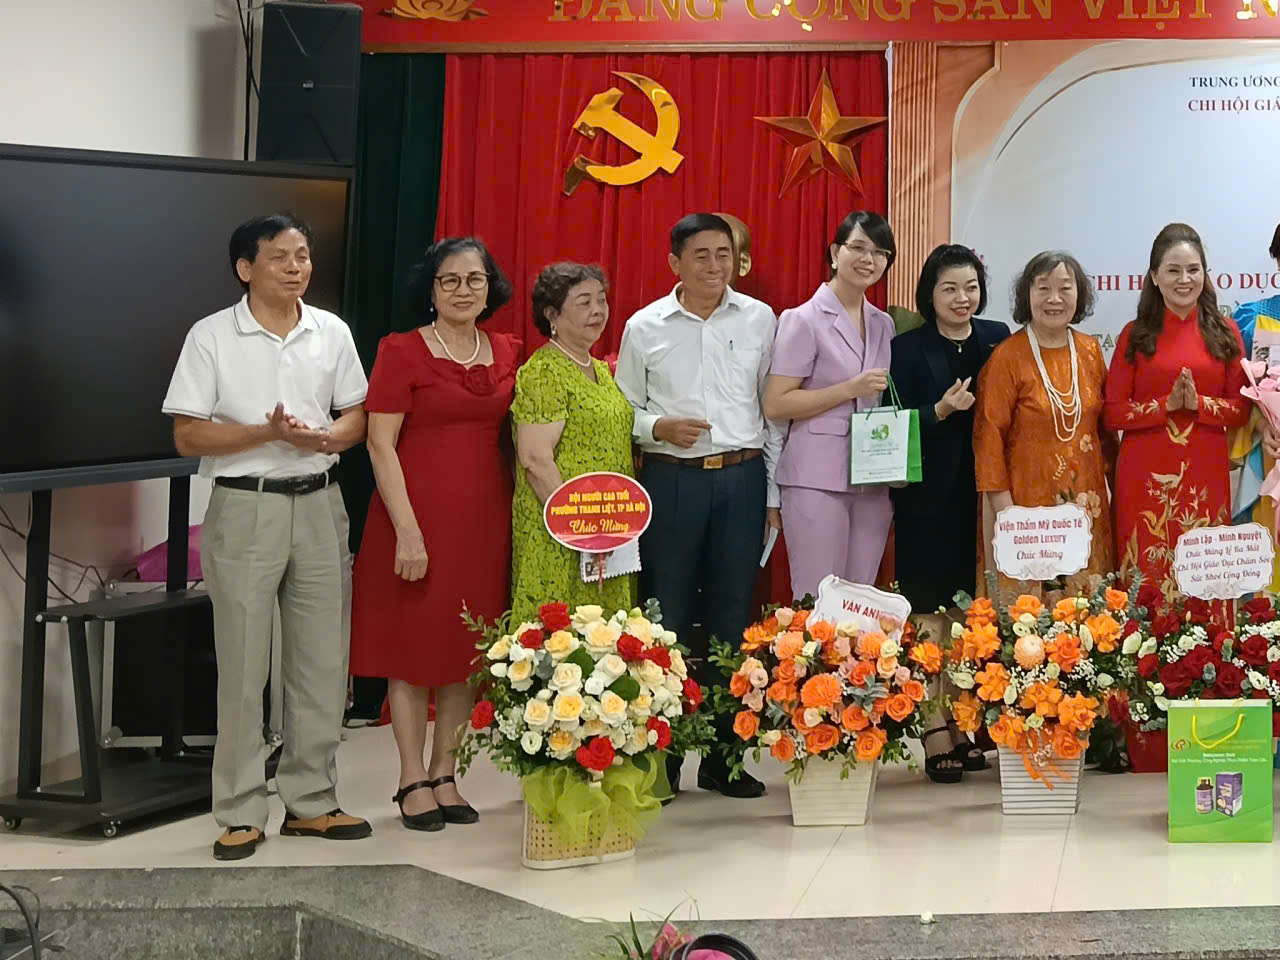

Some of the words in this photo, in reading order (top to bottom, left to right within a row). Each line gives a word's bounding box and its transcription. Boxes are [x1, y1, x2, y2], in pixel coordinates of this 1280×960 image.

[1189, 75, 1238, 88] TRUNG
[1188, 99, 1216, 112] CHI
[1221, 97, 1250, 114] HỘI
[999, 520, 1014, 533] Viện
[1016, 517, 1036, 530] Thẩm
[1038, 519, 1050, 530] Mỹ
[1052, 517, 1071, 529] Quốc
[1073, 516, 1083, 528] Tế
[1014, 535, 1039, 544] Golden
[1041, 534, 1067, 544] Luxury
[1184, 537, 1199, 546] Minh
[1219, 533, 1236, 541] Minh
[1238, 530, 1262, 541] Nguyệt
[1016, 550, 1036, 560] Chúc
[1039, 549, 1064, 560] Mừng
[862, 606, 880, 620] AN
